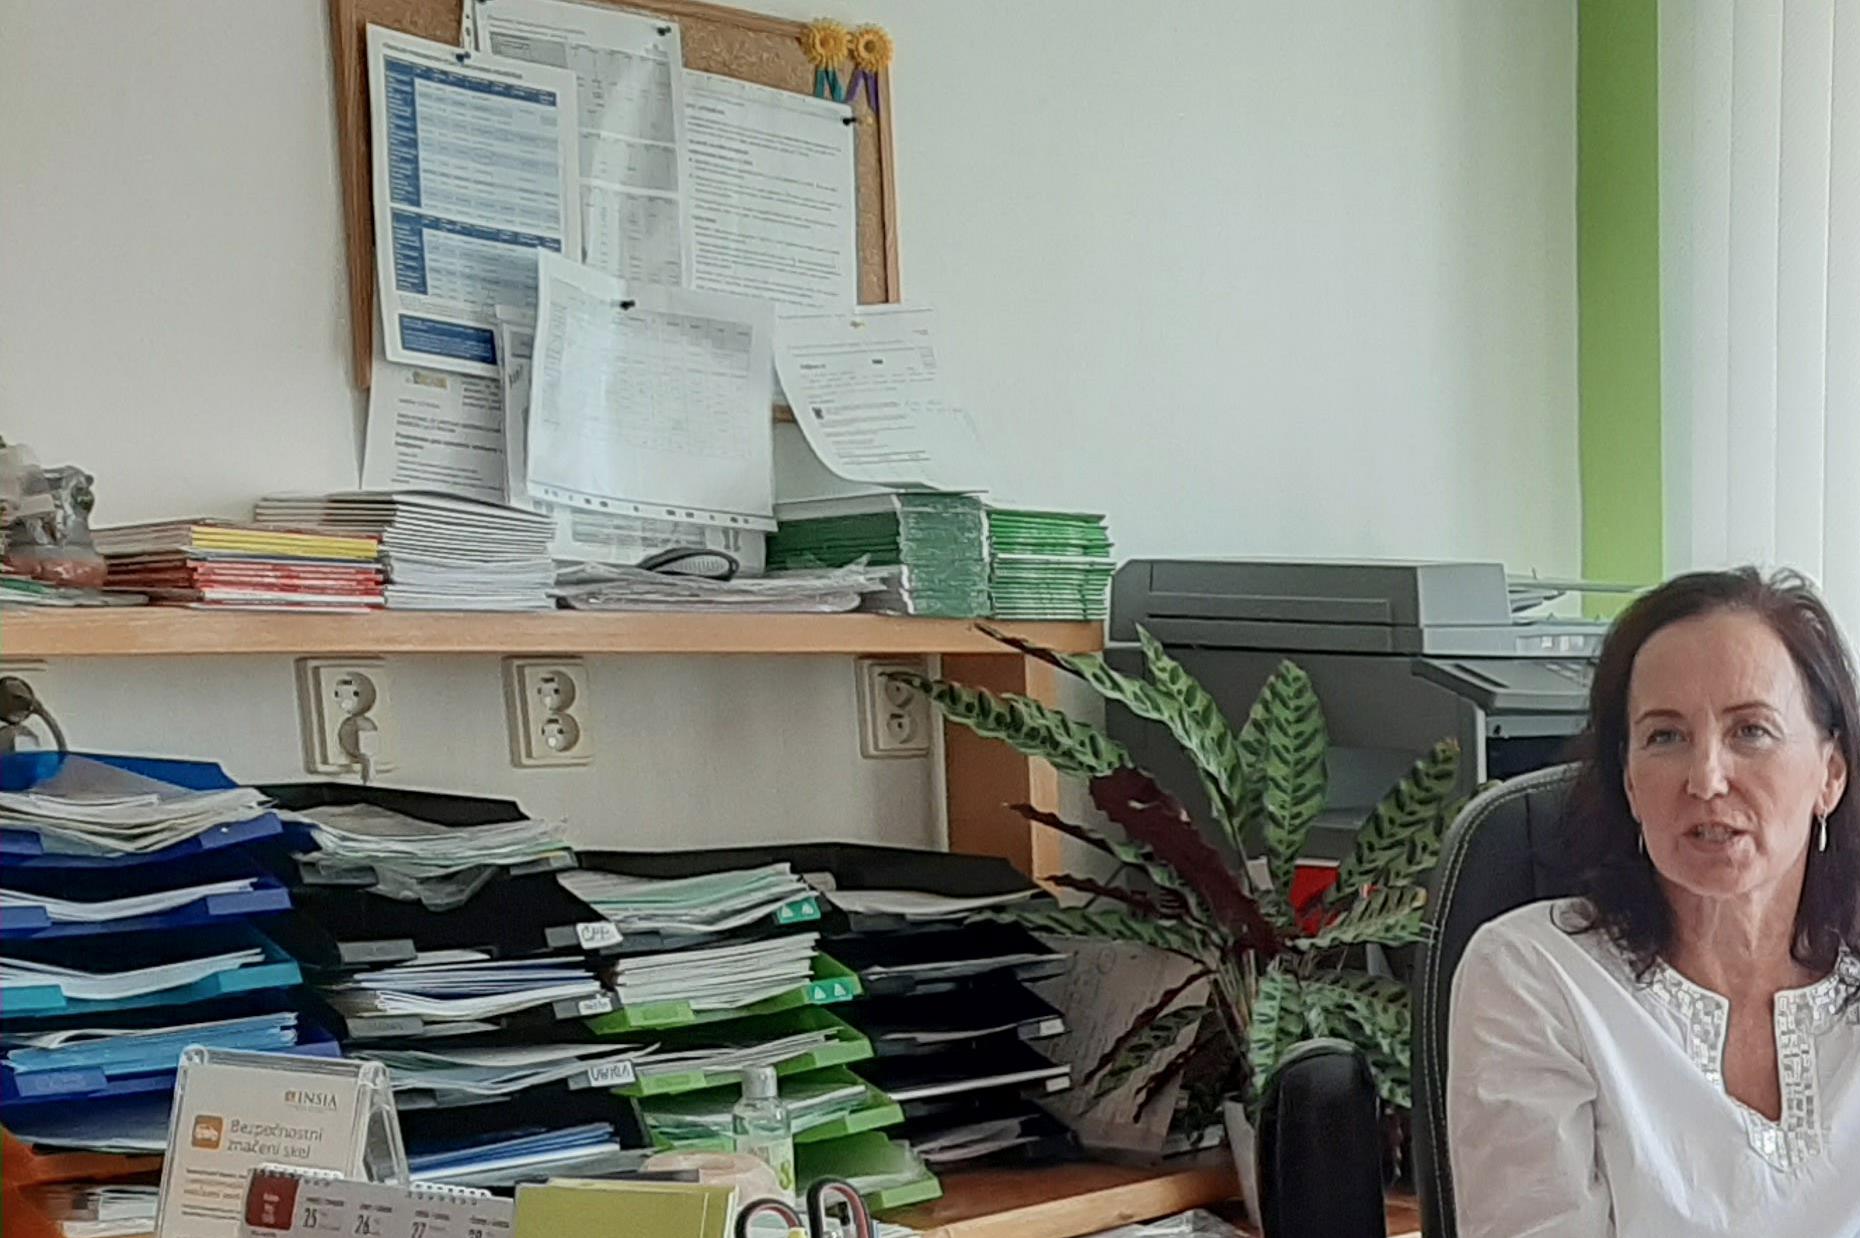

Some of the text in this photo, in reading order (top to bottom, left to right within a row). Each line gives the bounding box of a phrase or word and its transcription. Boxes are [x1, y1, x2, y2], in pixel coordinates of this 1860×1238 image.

[297, 1090, 338, 1111] INSIA
[231, 1118, 323, 1143] Bezpečnostní
[302, 1207, 318, 1229] 25
[354, 1214, 372, 1236] 26
